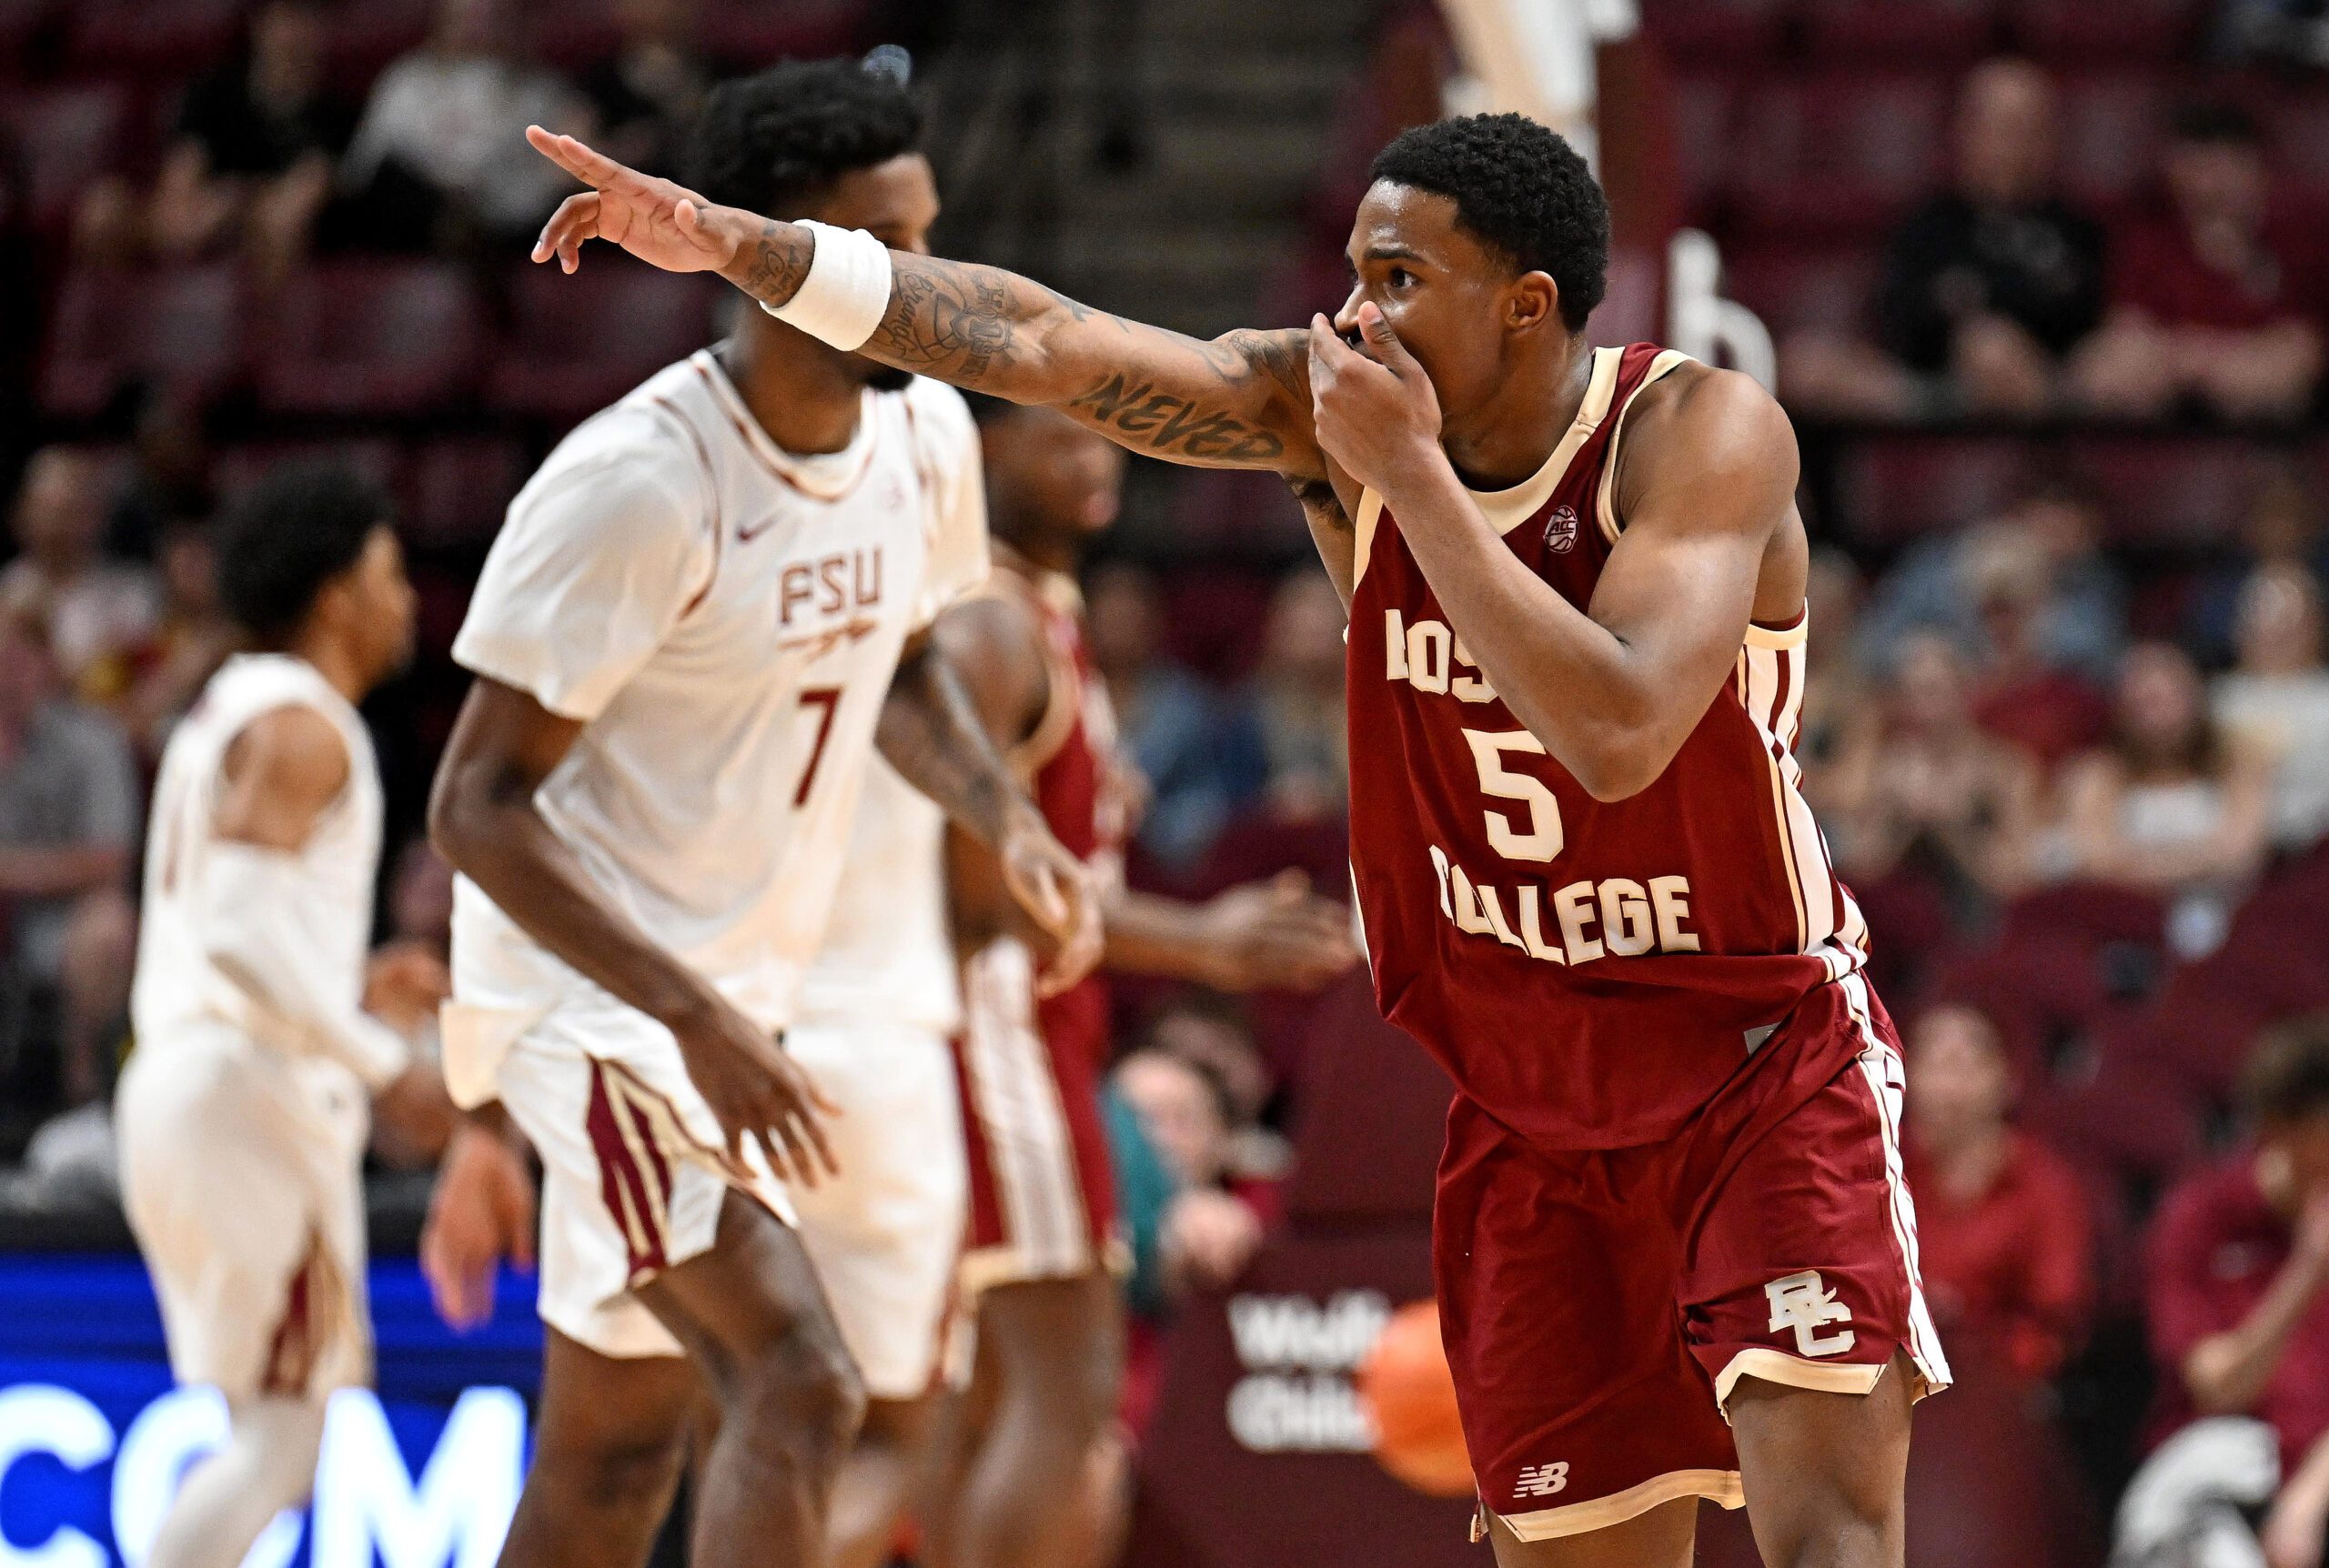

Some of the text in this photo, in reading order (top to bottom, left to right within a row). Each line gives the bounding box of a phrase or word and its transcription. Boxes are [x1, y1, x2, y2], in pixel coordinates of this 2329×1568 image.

[1547, 519, 1578, 535] ACC
[779, 547, 882, 624] FSU
[791, 689, 843, 808] 7
[1461, 728, 1564, 862] 5
